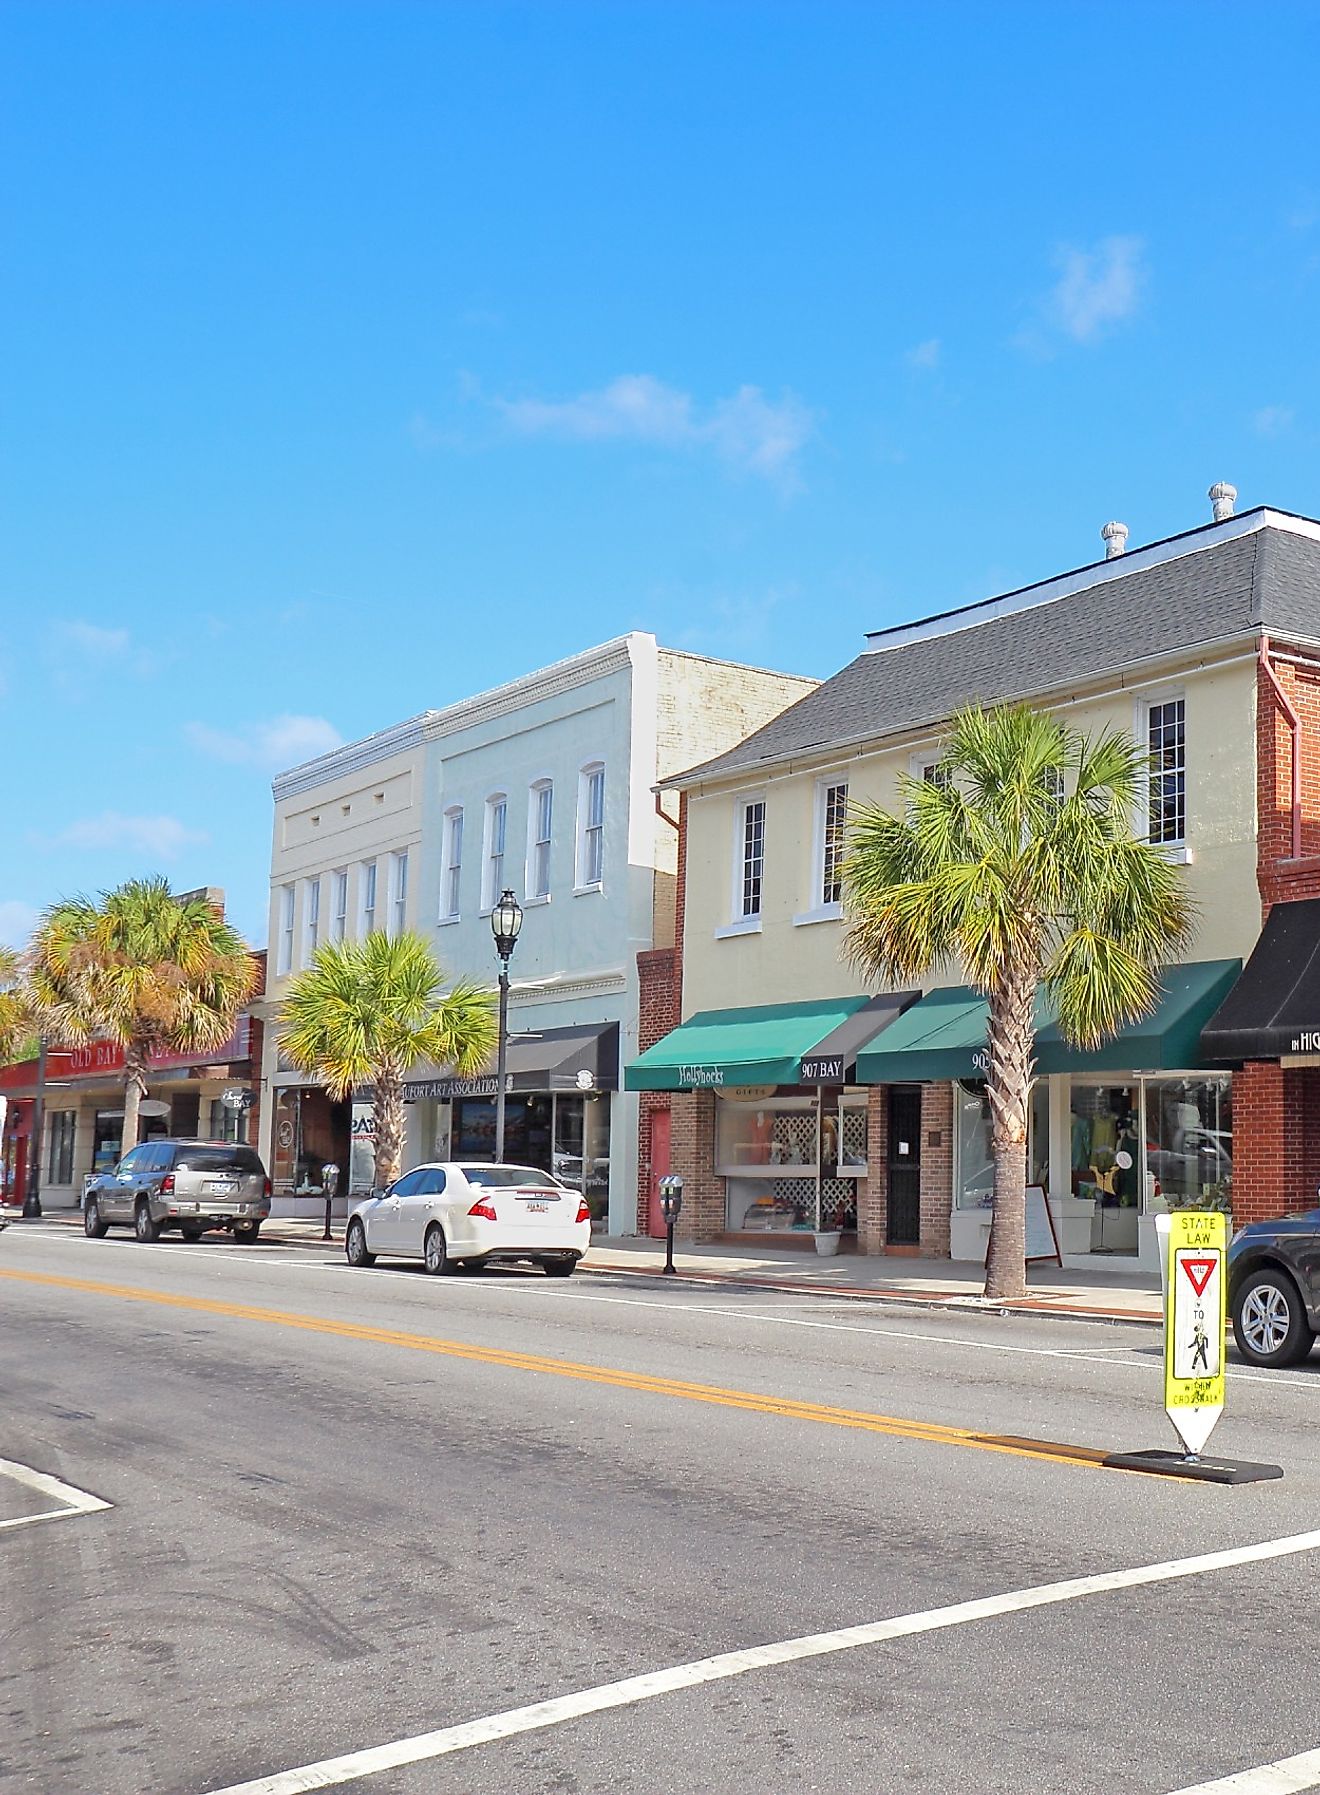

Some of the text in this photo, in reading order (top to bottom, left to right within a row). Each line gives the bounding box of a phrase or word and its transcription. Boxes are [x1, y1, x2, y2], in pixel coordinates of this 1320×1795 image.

[1291, 1040, 1299, 1051] IN
[70, 1045, 118, 1068] OLD BAY
[678, 1065, 724, 1086] Hollyhocks
[802, 1061, 841, 1078] 907 BAY
[430, 1082, 448, 1097] ART
[735, 1088, 766, 1096] GIFTS
[1182, 1217, 1216, 1230] STATE
[1187, 1233, 1211, 1244] LAW
[1194, 1310, 1204, 1320] TO
